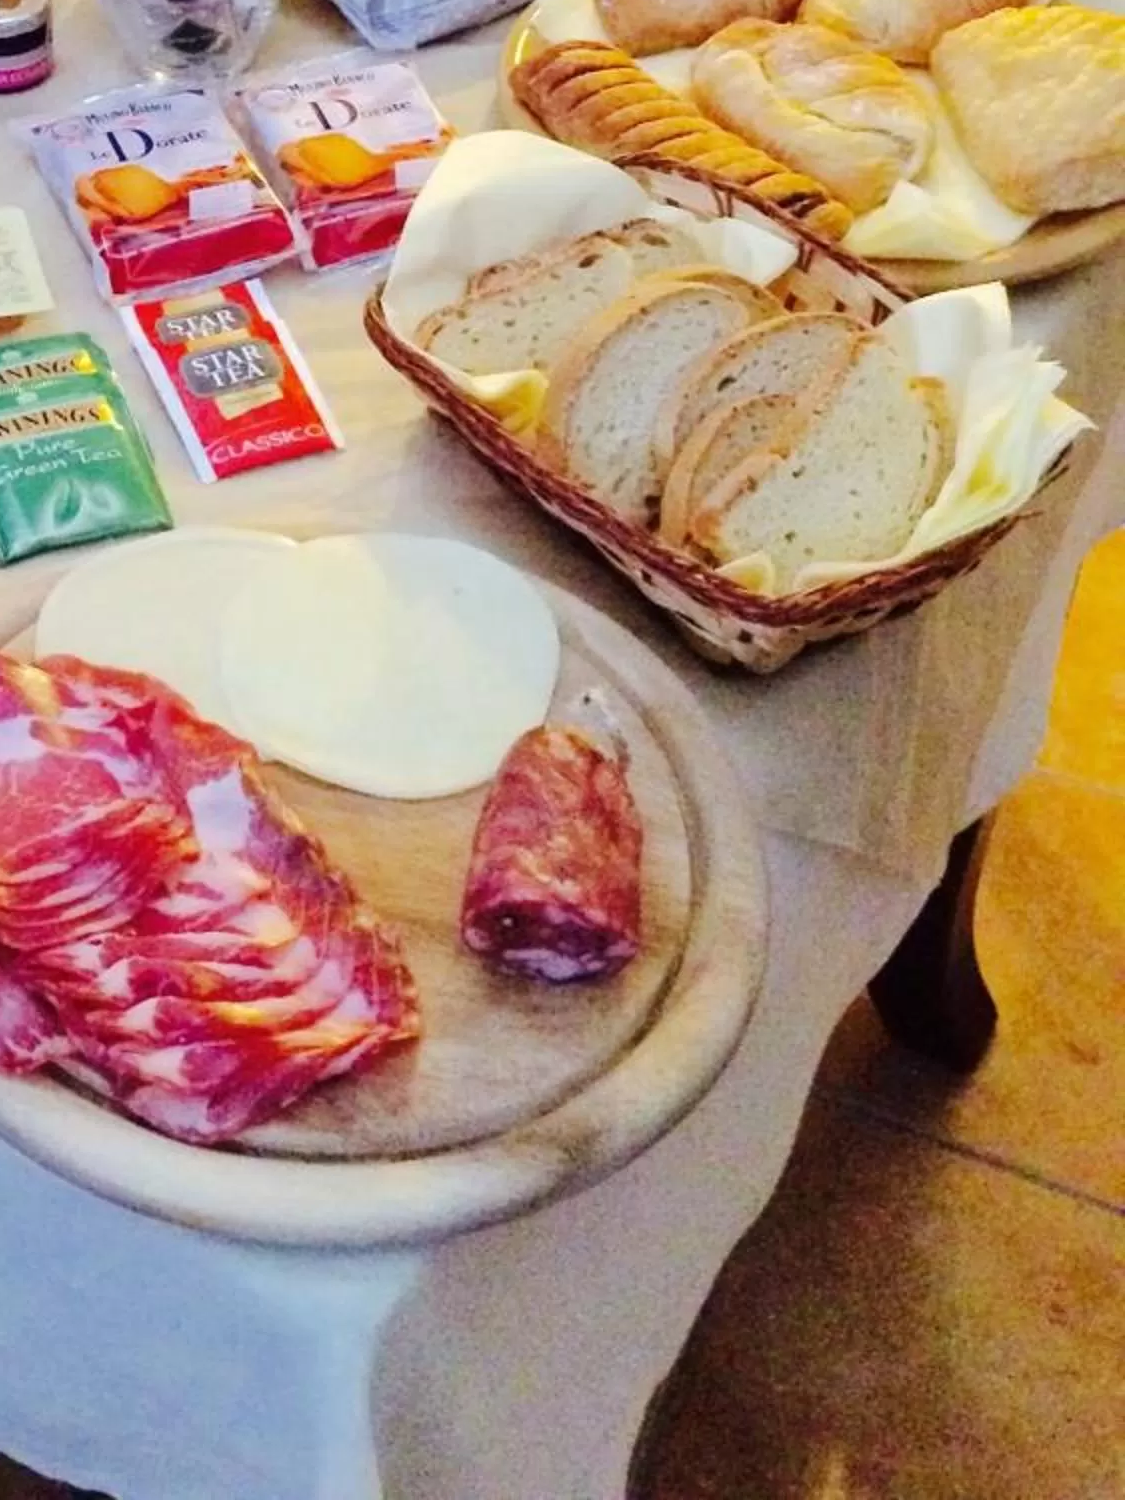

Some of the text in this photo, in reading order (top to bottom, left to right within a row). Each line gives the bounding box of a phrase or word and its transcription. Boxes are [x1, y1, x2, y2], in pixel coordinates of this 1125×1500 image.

[106, 128, 209, 162] Dorate
[165, 308, 237, 337] STAR
[190, 343, 264, 376] STAR
[209, 361, 266, 389] TEA
[16, 438, 77, 462] Pure
[74, 447, 123, 465] Tea
[211, 422, 325, 464] CLASSICO
